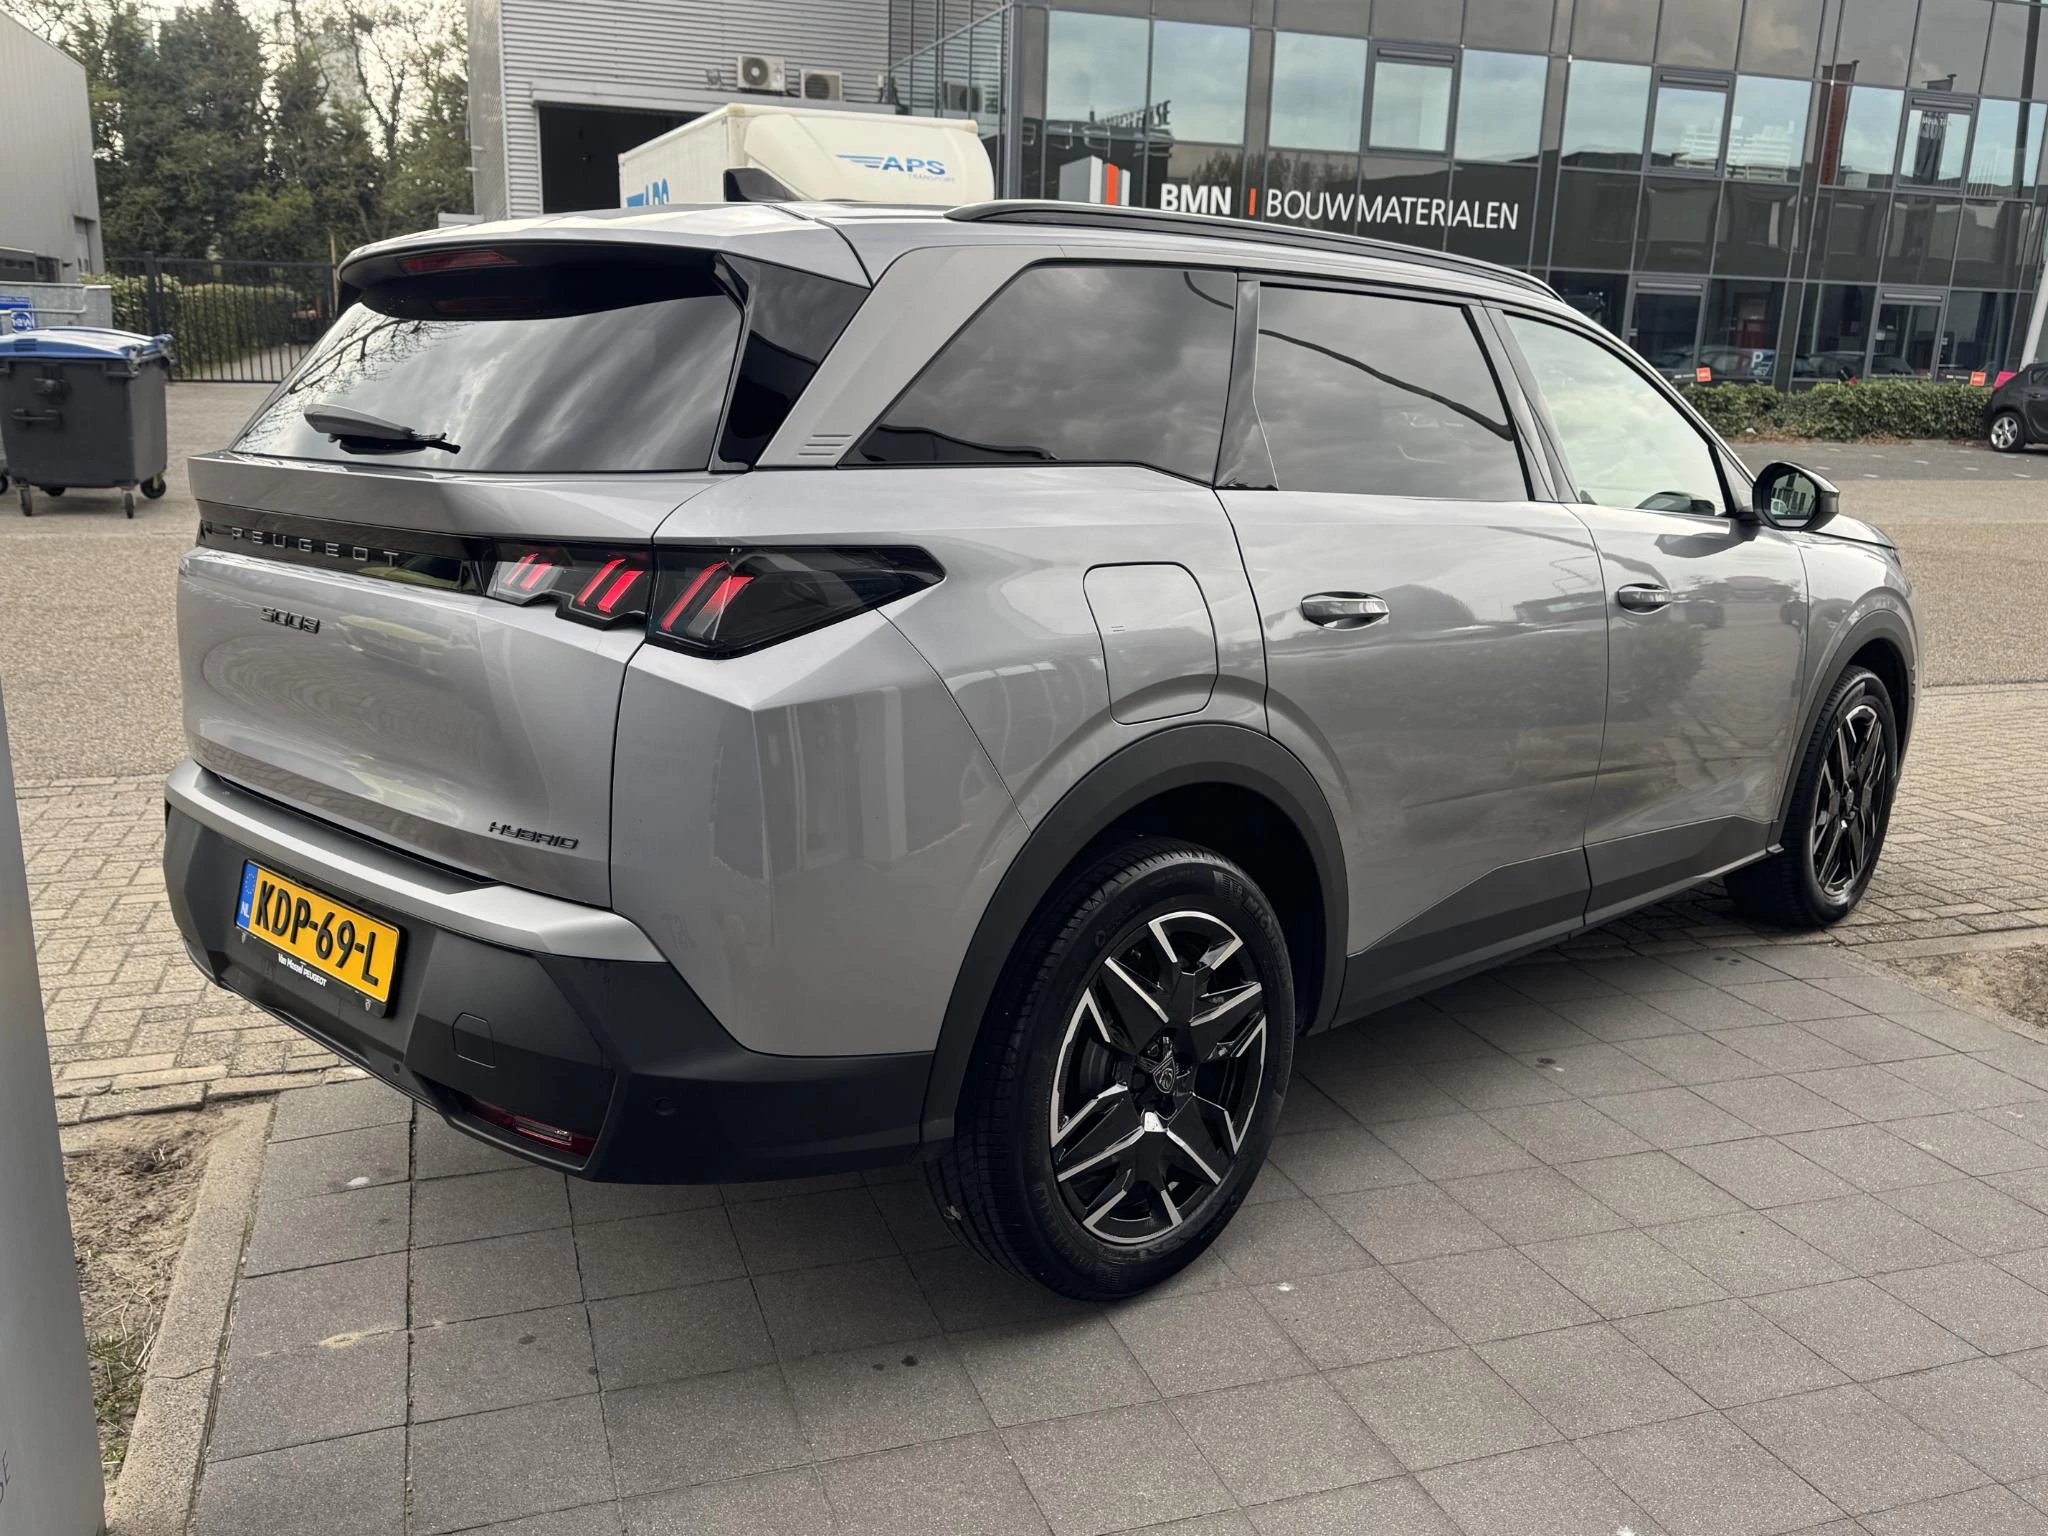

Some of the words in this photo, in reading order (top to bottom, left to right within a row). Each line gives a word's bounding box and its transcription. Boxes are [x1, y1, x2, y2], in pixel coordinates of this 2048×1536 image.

[882, 156, 946, 175] APS
[1160, 184, 1232, 215] BMN
[1266, 189, 1519, 230] BOUWMATERIALEN
[231, 527, 400, 567] PEUGEOT
[488, 821, 580, 850] HYBRID
[240, 901, 250, 919] NL
[255, 880, 379, 987] KDP-69-L
[278, 953, 287, 966] Van
[303, 967, 328, 987] PEUGEOT
